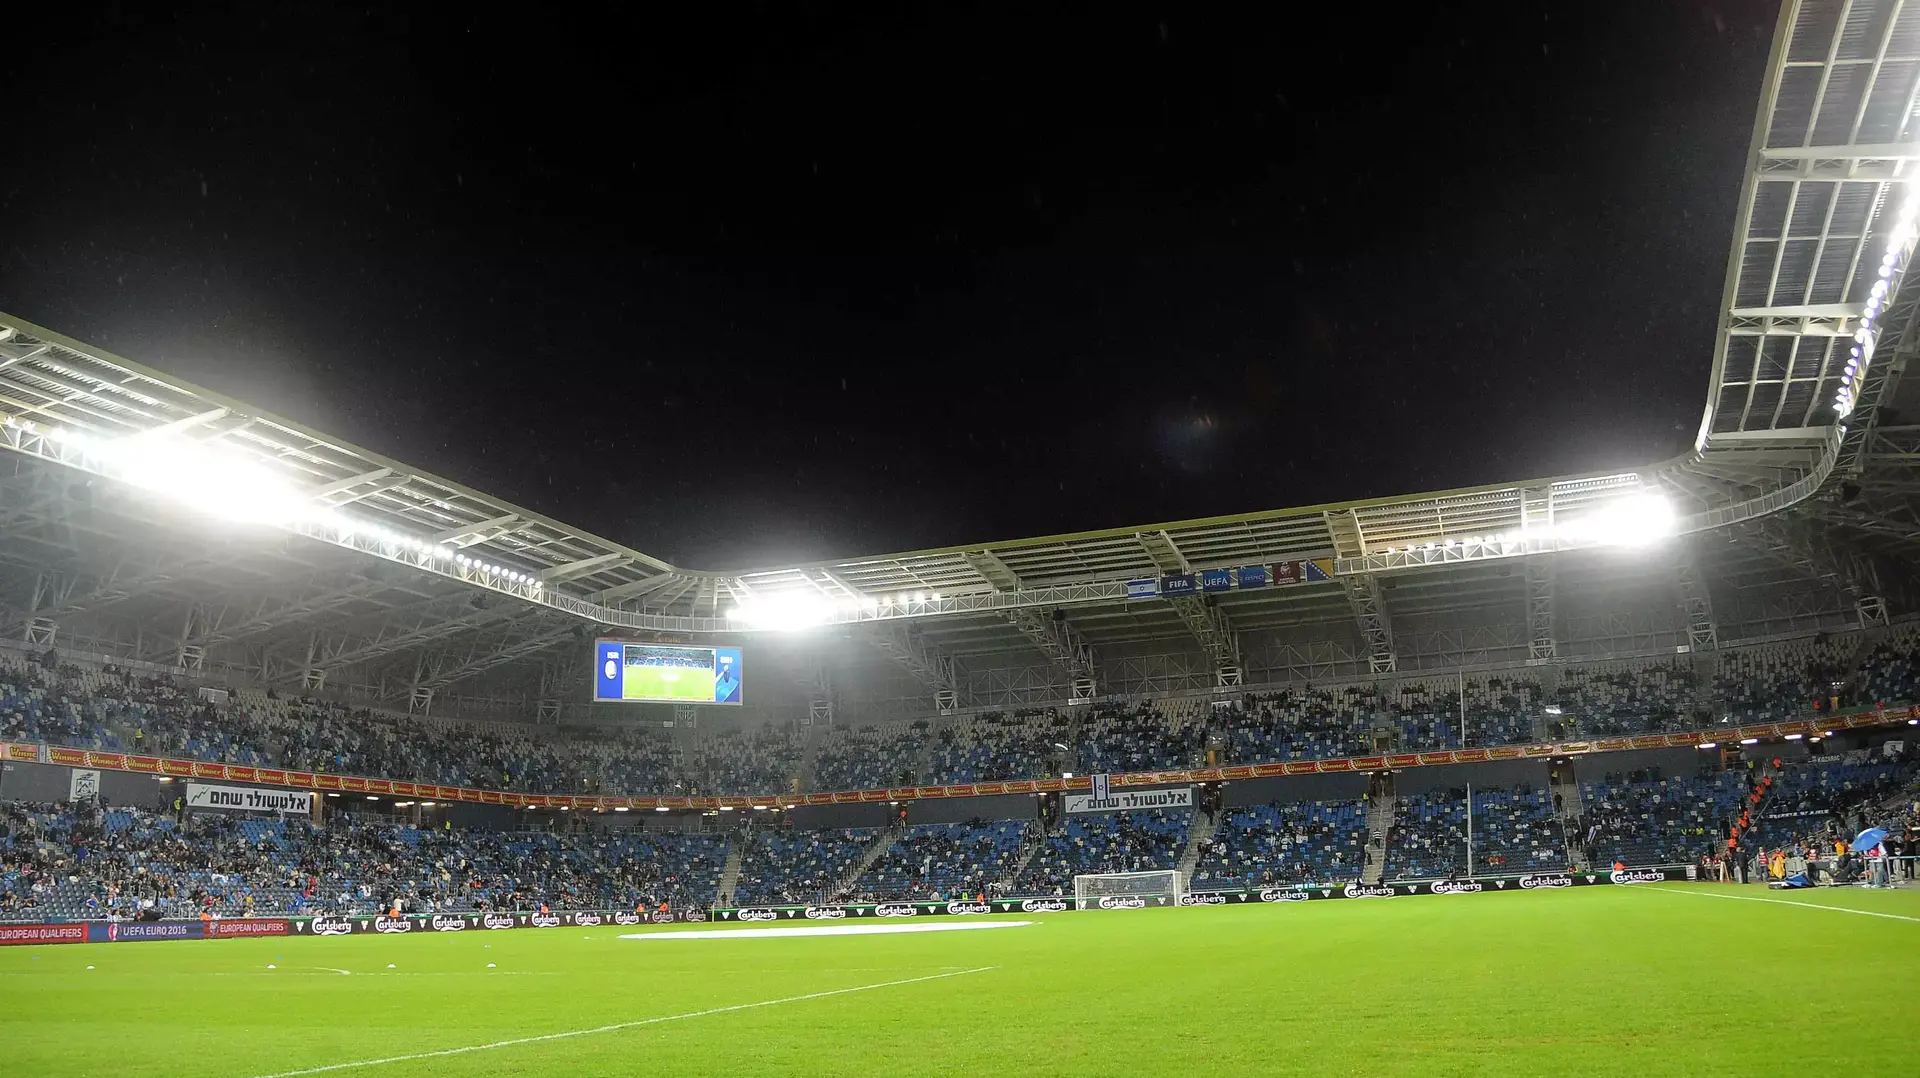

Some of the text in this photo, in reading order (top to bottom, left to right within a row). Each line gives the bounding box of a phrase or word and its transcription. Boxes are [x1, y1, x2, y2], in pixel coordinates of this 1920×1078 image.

[1169, 580, 1188, 588] FIFA
[1204, 578, 1228, 587] UEFA
[1706, 732, 1734, 740] Winner
[1742, 728, 1770, 737] Winner
[1633, 739, 1661, 747] Winner
[1670, 735, 1697, 744] Winner
[1525, 747, 1553, 755] Winner
[1561, 744, 1589, 752] Winner
[1596, 742, 1624, 750] Winner
[10, 747, 37, 758] Winne
[51, 752, 82, 762] Winner
[1456, 752, 1482, 761] Winner
[1491, 749, 1517, 758] Winner
[91, 755, 118, 766] Winner
[128, 758, 154, 769] Winner
[1355, 760, 1380, 768] Winner
[1388, 758, 1413, 766] Winner
[1422, 755, 1448, 763] Winner
[163, 761, 188, 772] Winner
[197, 764, 221, 776] Winner
[1256, 767, 1280, 775] Winner
[1288, 764, 1313, 772] Winner
[1320, 762, 1347, 770] Winner
[229, 768, 252, 779] Winner
[260, 771, 282, 781] Winner
[1190, 772, 1215, 780] Winner
[1223, 769, 1248, 777] Winner
[289, 774, 310, 784] Winner
[317, 777, 337, 786] Winner
[1067, 780, 1090, 788] Winner
[343, 780, 363, 789] Winner
[368, 782, 388, 790] Winner
[1007, 784, 1029, 792] Winner
[1036, 782, 1059, 790] Winner
[892, 790, 914, 798] Winner
[949, 787, 970, 795] Winner
[210, 790, 306, 810] אלטשולר שחם
[721, 798, 744, 806] Winner
[1088, 791, 1188, 808] אלטשולר שחם
[1519, 875, 1572, 889] Carlsberg
[1610, 870, 1664, 884] Carlsberg
[1344, 886, 1394, 898] Carlsberg
[1431, 881, 1482, 894] Carlsberg
[1180, 894, 1226, 906] Carlsberg
[1260, 890, 1308, 902] Carlsberg
[1022, 900, 1066, 912] Carlsberg
[1099, 897, 1145, 909] Carlsberg
[805, 907, 845, 919] Carlsberg
[875, 905, 917, 917] Carlsberg
[947, 903, 990, 915] Carlsberg
[532, 913, 560, 927] Carlsberg
[575, 912, 601, 926] Carlsberg
[615, 912, 639, 925] Carlsberg
[652, 911, 673, 923] Carlsberg
[686, 910, 706, 922] Carlsberg
[738, 909, 777, 921] Carlsberg
[312, 917, 352, 935] Carlsberg
[375, 916, 411, 933] Carlsberg
[433, 916, 465, 931] Carlsberg
[484, 914, 513, 929] Carlsberg
[123, 926, 187, 936] UEFA EURO 2016
[220, 923, 284, 932] EUROPEAN QUALIFIERS
[40, 928, 82, 939] QUALIFIERS
